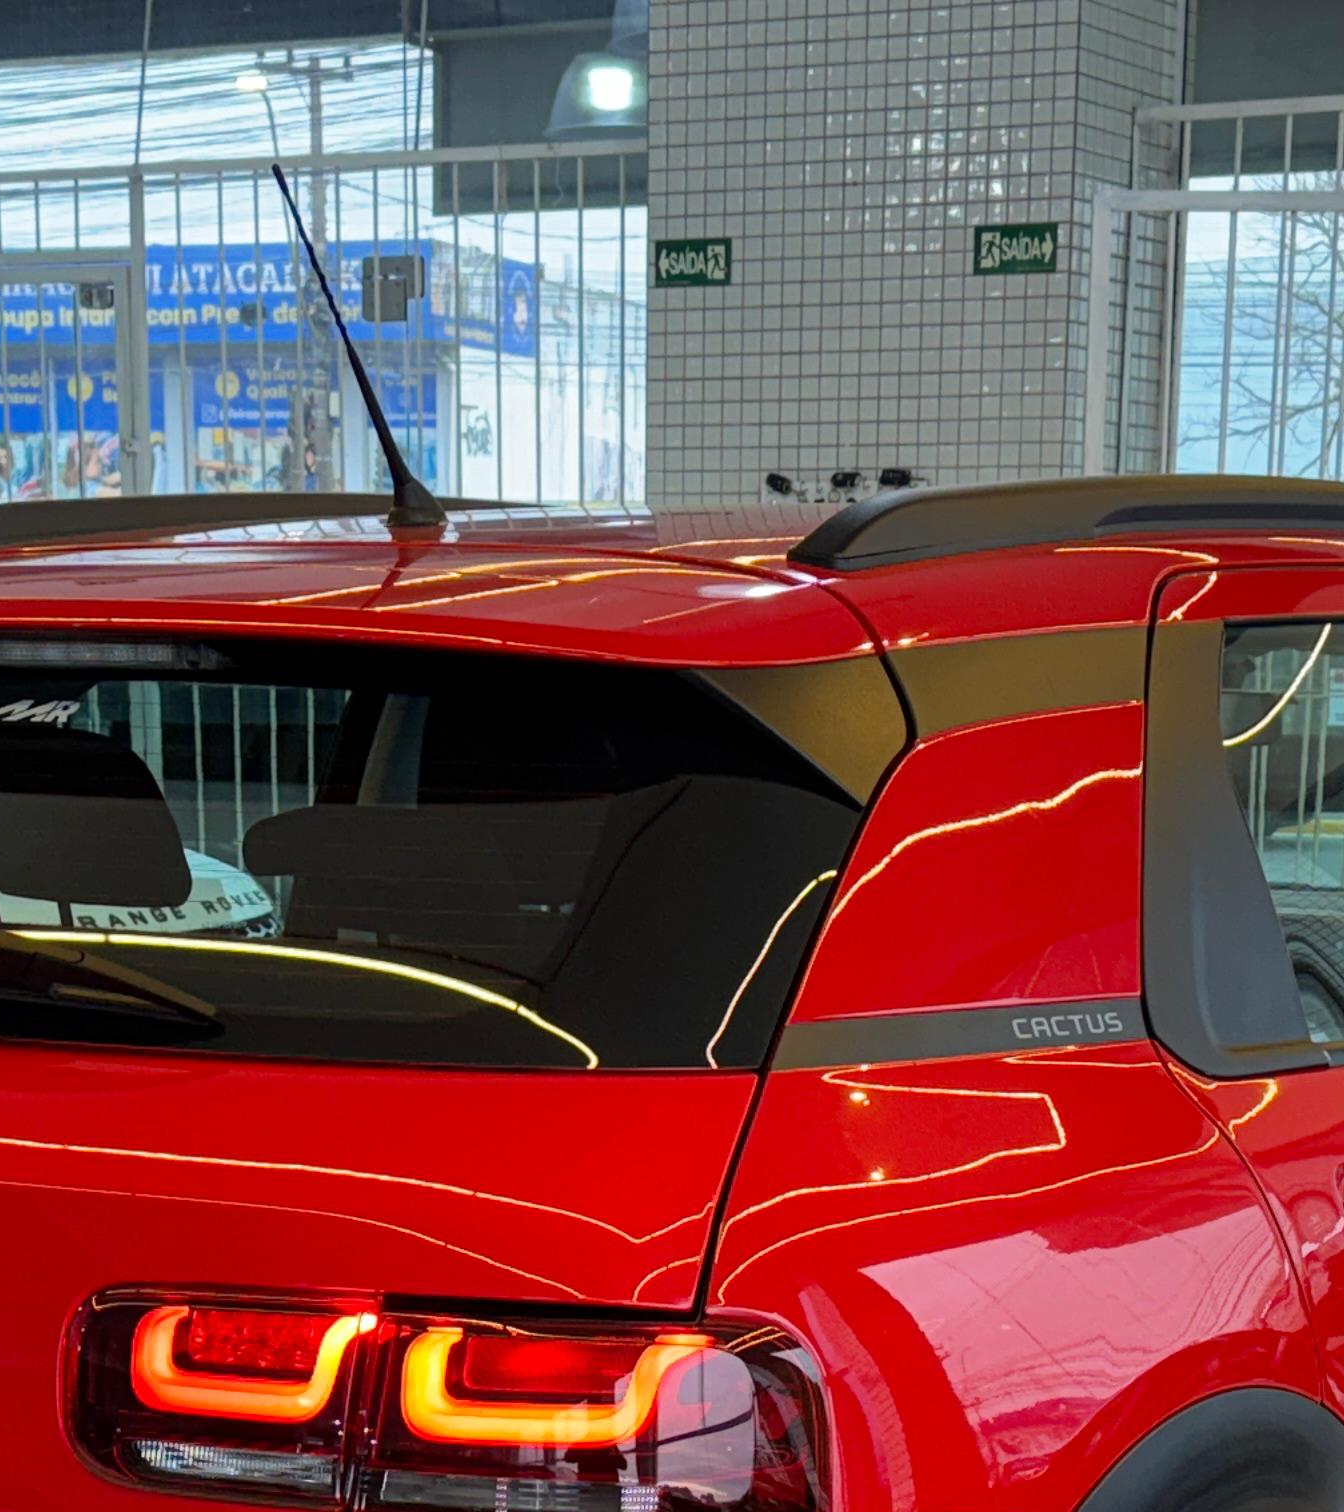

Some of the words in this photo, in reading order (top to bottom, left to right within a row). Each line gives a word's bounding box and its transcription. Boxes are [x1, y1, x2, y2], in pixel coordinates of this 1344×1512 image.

[668, 244, 707, 275] SAÍDA
[1001, 231, 1042, 261] SAÍDA
[169, 262, 301, 294] ATACAD
[76, 906, 187, 929] RANGE
[1011, 1011, 1124, 1039] CACTUS
